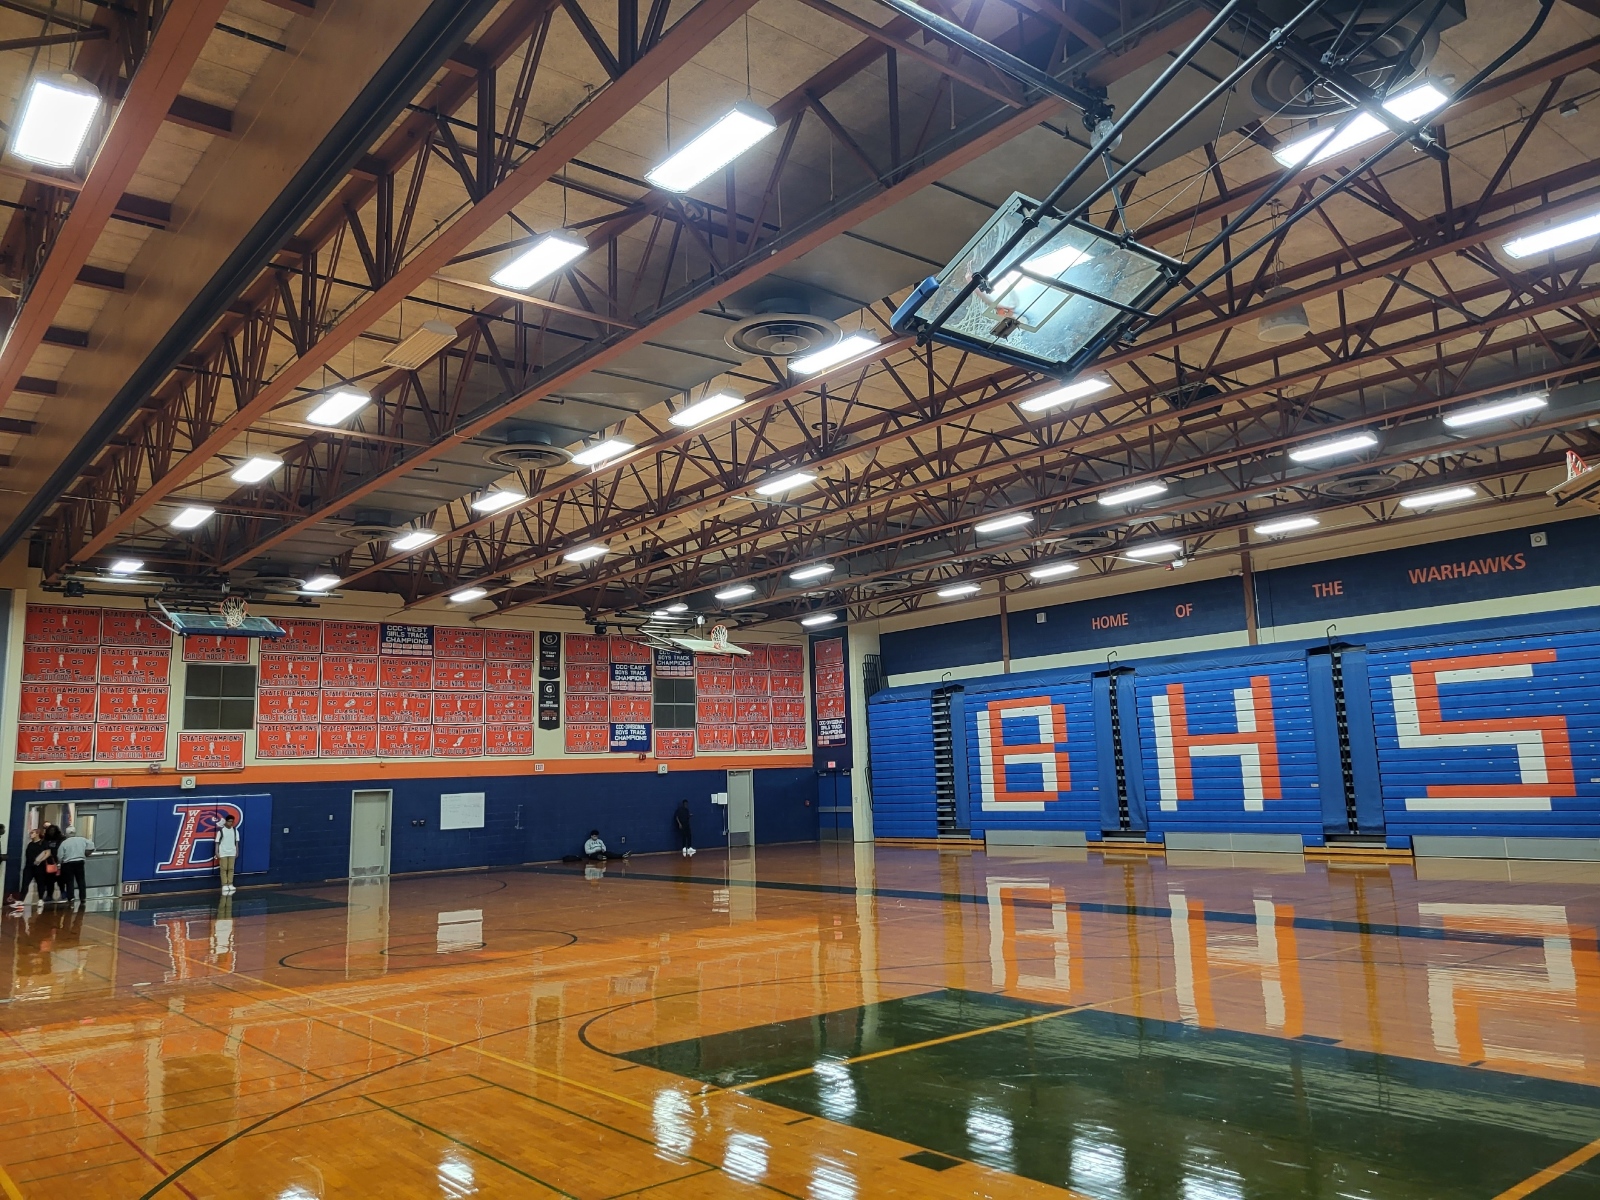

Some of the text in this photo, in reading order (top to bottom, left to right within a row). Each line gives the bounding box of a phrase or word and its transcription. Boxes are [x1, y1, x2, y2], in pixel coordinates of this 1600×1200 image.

[1092, 552, 1526, 630] HOME OF THE WARHAWKS
[977, 648, 1577, 811] B H S
[156, 803, 243, 874] B
[176, 810, 200, 866] WARHAWKS
